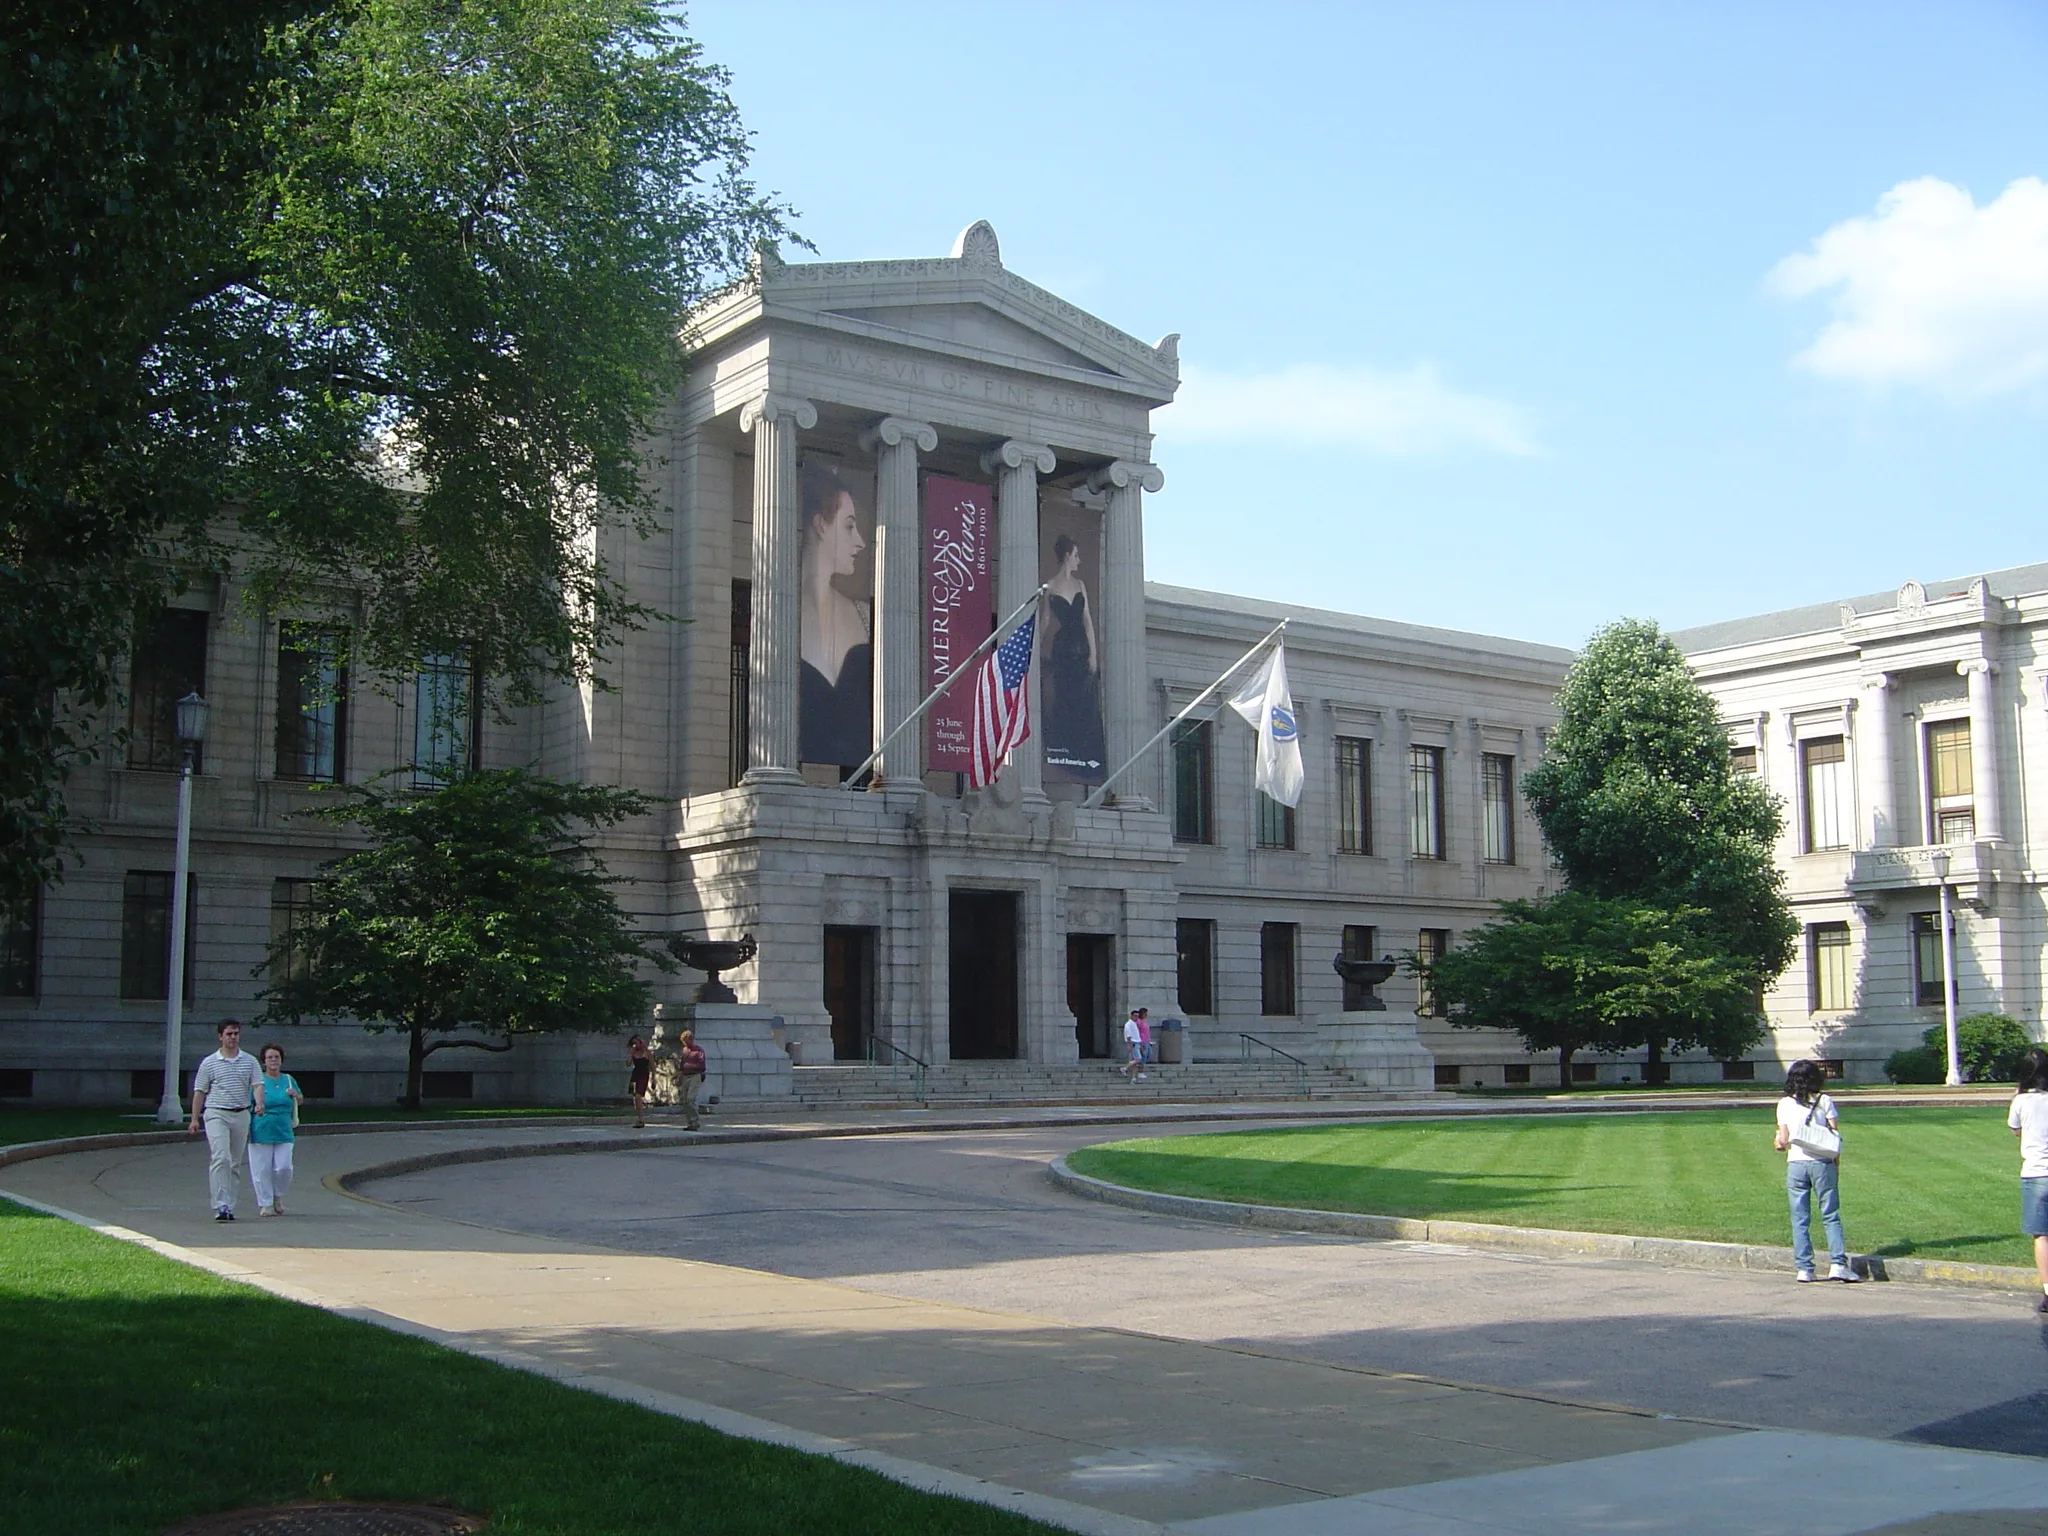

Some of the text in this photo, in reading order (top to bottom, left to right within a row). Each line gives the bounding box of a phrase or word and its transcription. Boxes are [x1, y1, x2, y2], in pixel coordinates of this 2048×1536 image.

[941, 371, 969, 392] OF
[984, 380, 1036, 407] FINE
[1050, 396, 1103, 420] ARTS
[944, 499, 976, 607] IN Paris
[936, 717, 963, 728] 25 June
[936, 729, 965, 743] through
[937, 743, 946, 753] 24
